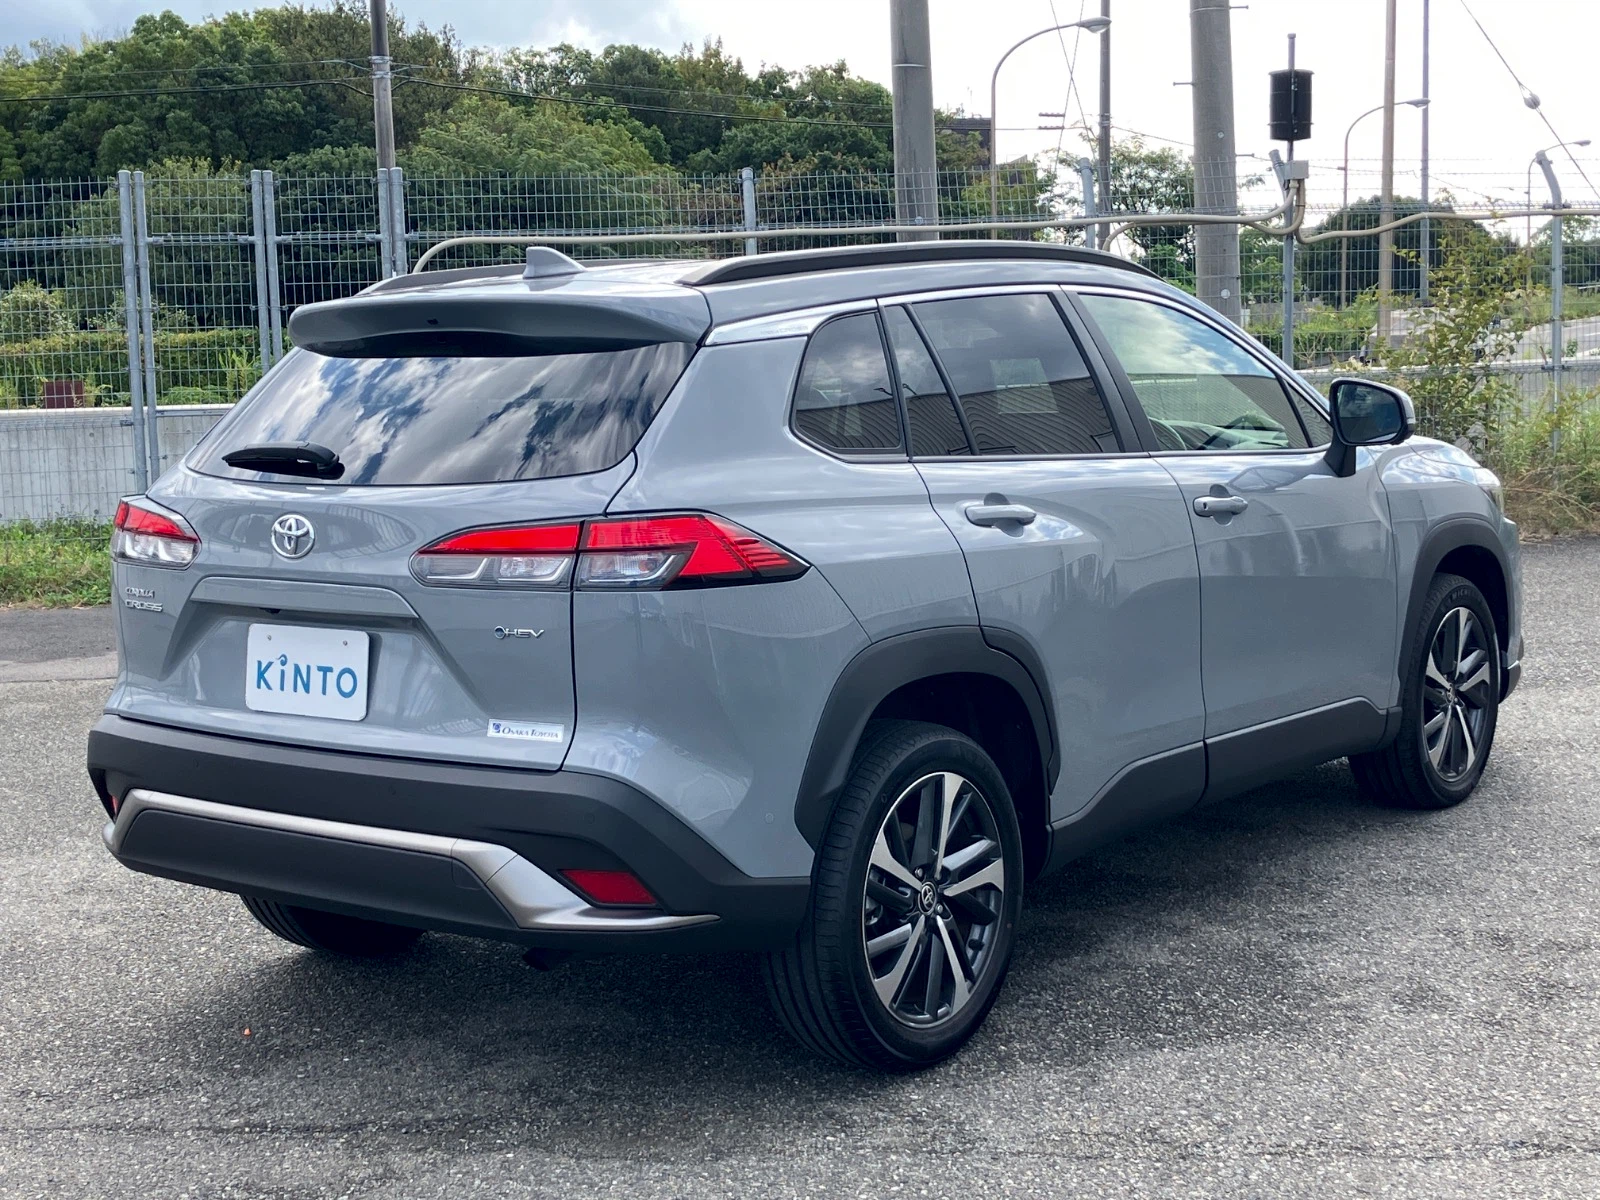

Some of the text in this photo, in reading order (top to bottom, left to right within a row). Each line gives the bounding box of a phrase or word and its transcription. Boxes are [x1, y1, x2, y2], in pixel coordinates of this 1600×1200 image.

[125, 600, 163, 612] CROSS
[502, 726, 559, 738] OSAKA TOYOTA
